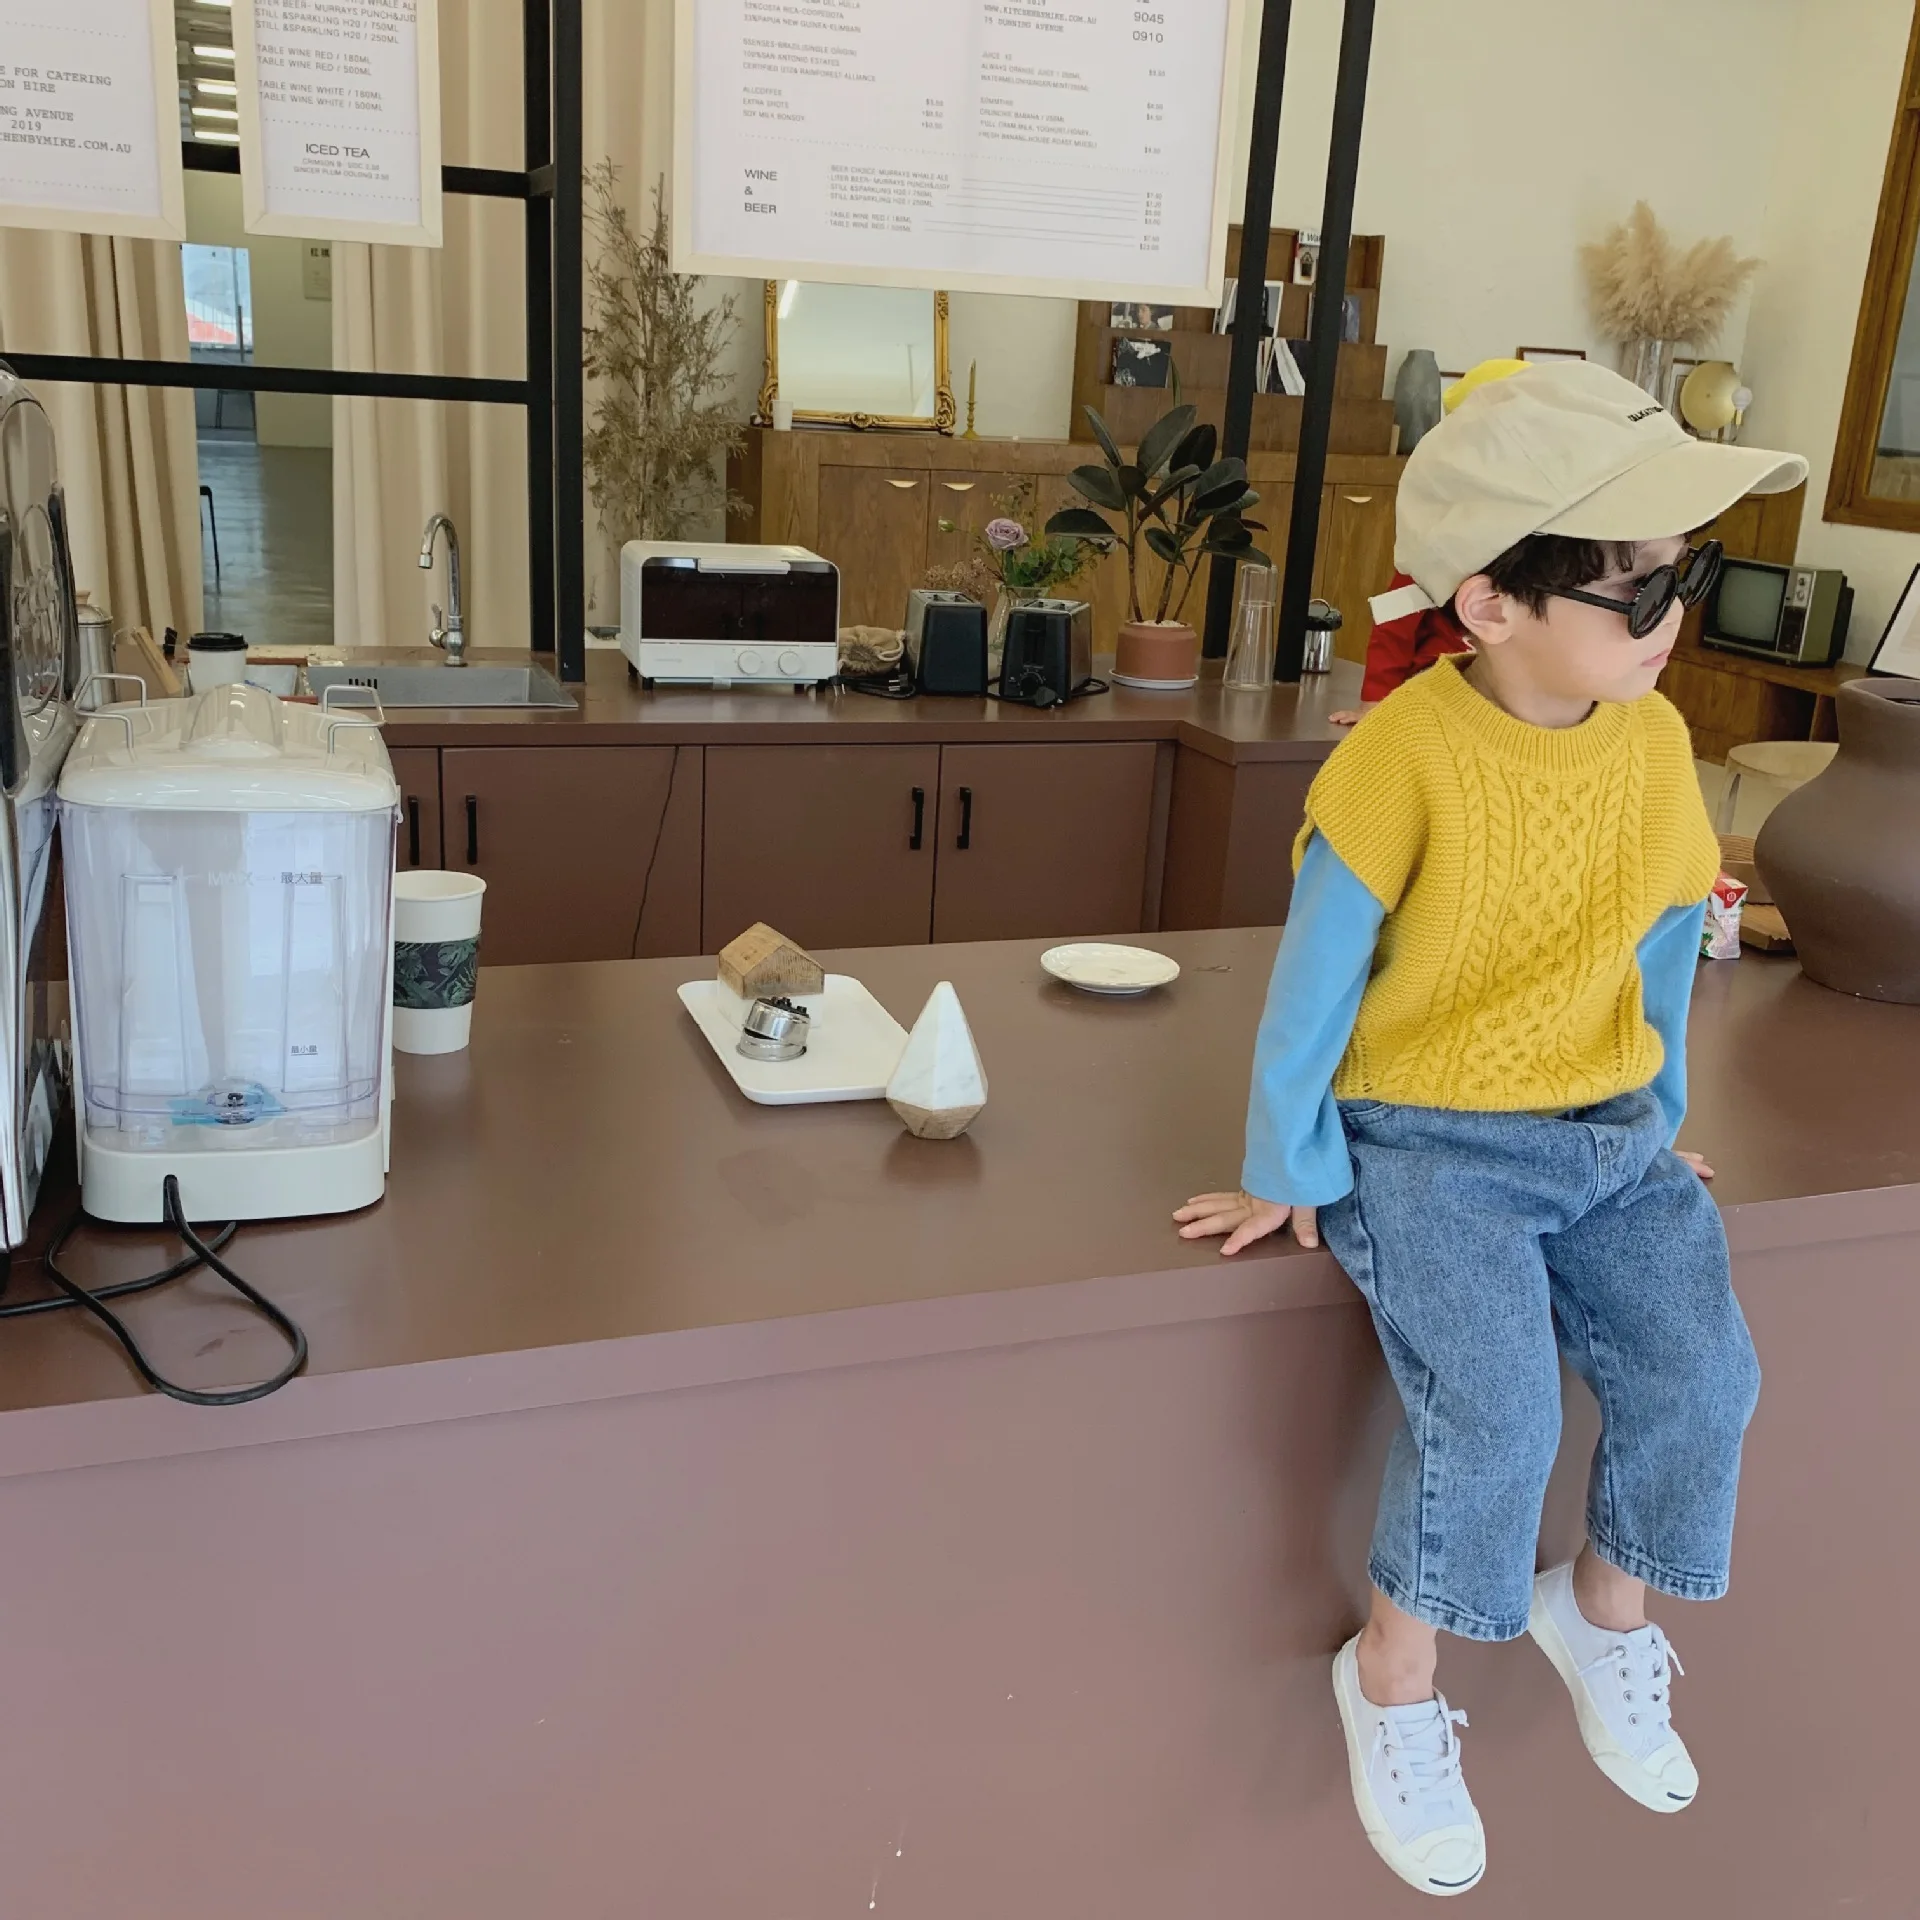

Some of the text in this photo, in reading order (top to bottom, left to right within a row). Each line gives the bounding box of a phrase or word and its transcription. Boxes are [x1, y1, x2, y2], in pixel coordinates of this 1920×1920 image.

[315, 4, 358, 15] MURRAYS
[255, 8, 279, 18] STILL
[282, 11, 340, 25] &SPARKLING
[371, 22, 399, 32] 750ML
[1134, 11, 1164, 24] 9045
[255, 20, 279, 30] STILL
[282, 23, 340, 37] &SPARKLING
[371, 34, 399, 44] 250ML
[1132, 30, 1164, 43] 0910
[257, 44, 284, 55] TABLE
[288, 47, 311, 58] WINE
[315, 50, 333, 60] RED
[344, 54, 372, 64] 180ML
[257, 56, 284, 67] TABLE
[288, 59, 311, 69] WINE
[315, 62, 334, 72] RED
[344, 66, 372, 76] 500ML
[14, 67, 39, 78] FOR
[47, 70, 112, 86] CATERING
[24, 81, 56, 93] HIRE
[258, 80, 286, 91] TABLE
[289, 83, 312, 93] WINE
[317, 86, 345, 96] WHITE
[355, 90, 383, 100] 180ML
[259, 91, 286, 102] TABLE
[290, 95, 313, 105] WINE
[317, 98, 345, 108] WHITE
[355, 101, 383, 112] 500ML
[26, 108, 74, 121] AVENUE
[11, 120, 42, 131] 2019
[0, 132, 132, 154] HENBYMIKE.COM.AU
[306, 143, 370, 158] ICED TEA
[744, 169, 778, 181] WINE
[744, 185, 753, 195] &
[744, 202, 777, 214] BEER
[281, 871, 323, 885] 最大量
[291, 1044, 318, 1054] 最小量
